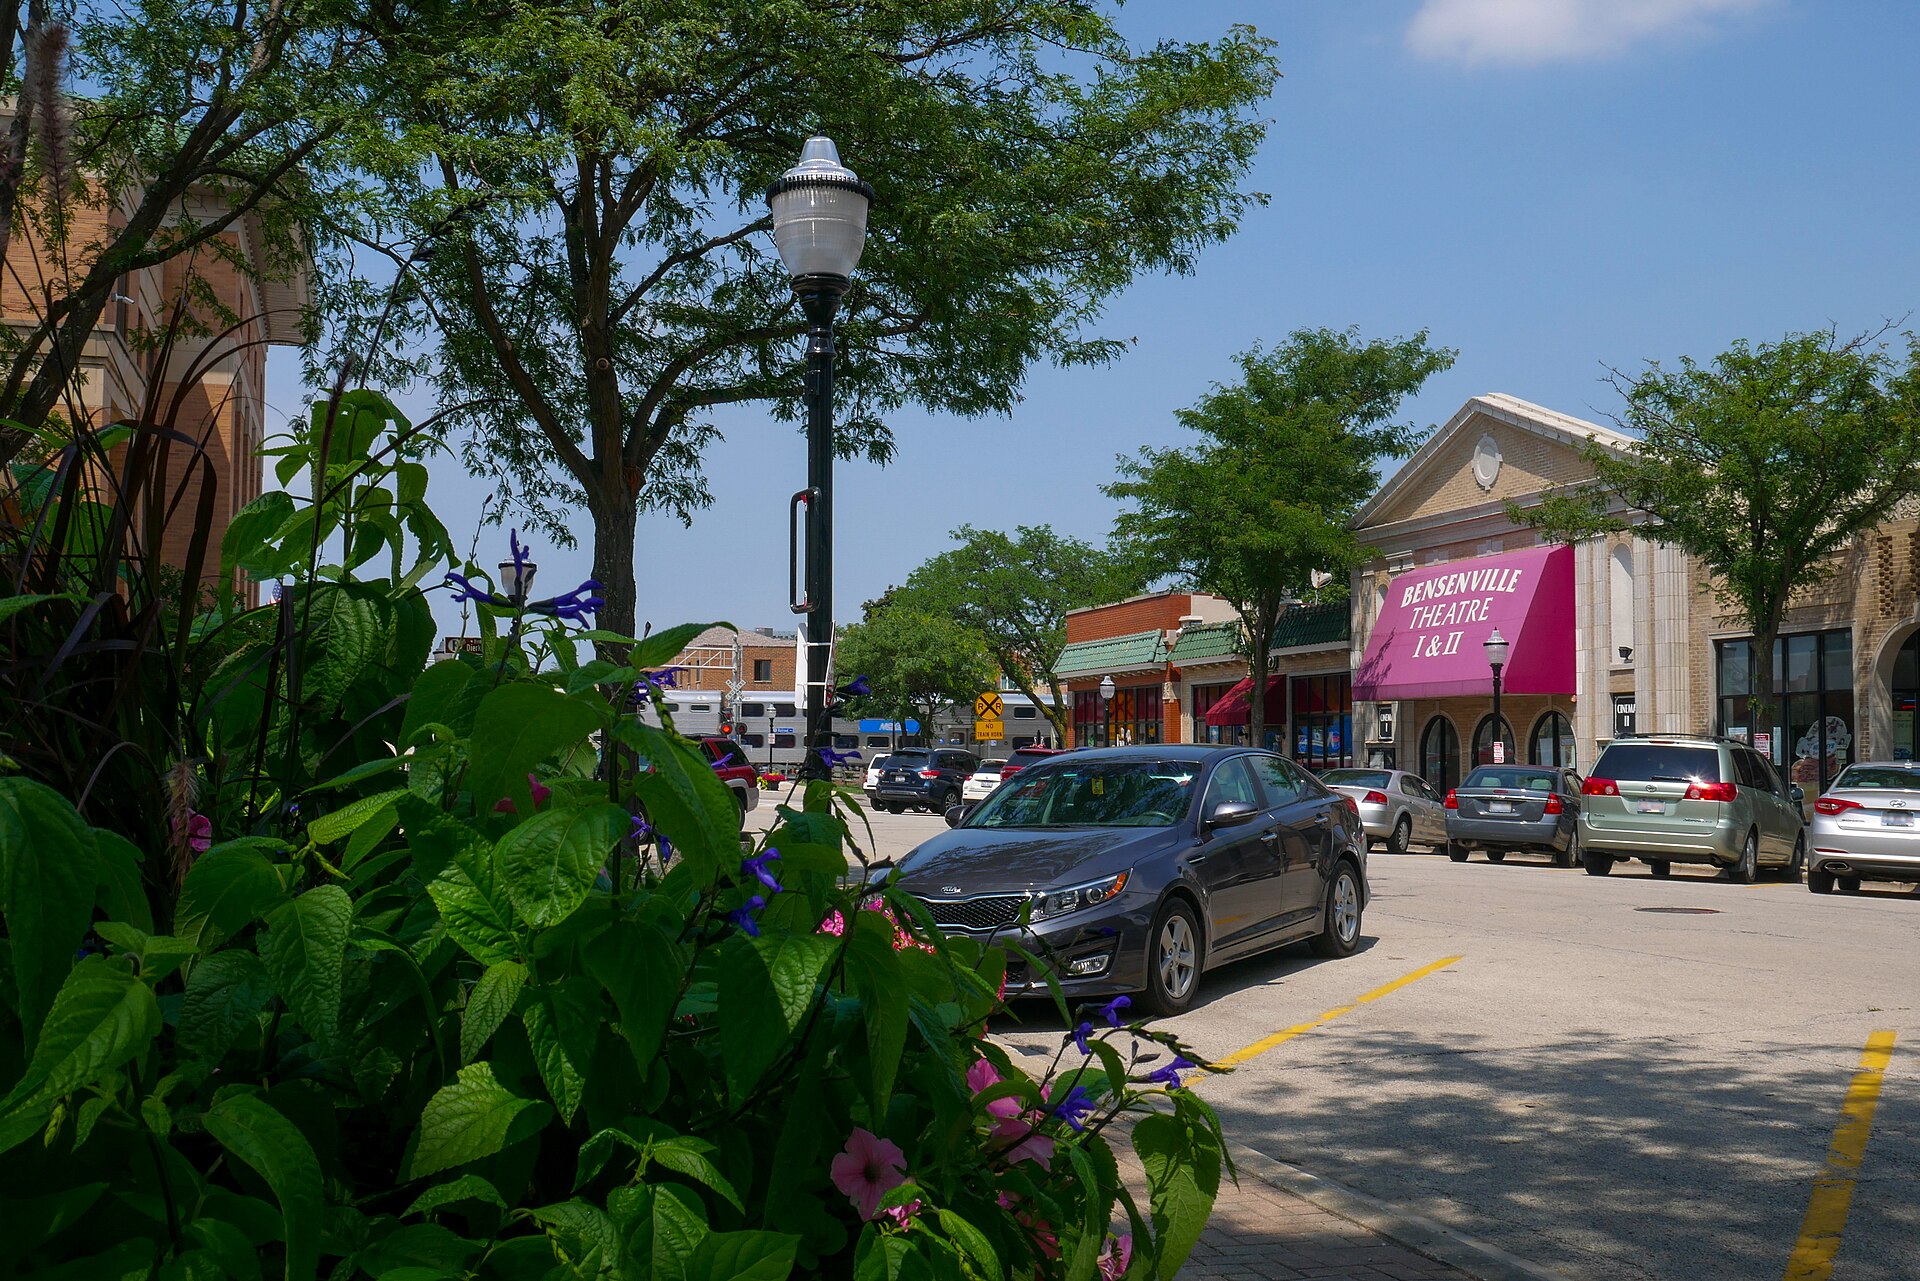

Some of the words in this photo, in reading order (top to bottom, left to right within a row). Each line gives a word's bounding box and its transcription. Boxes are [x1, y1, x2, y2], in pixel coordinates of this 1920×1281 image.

[1400, 568, 1522, 608] BENSENVILLE
[1409, 597, 1493, 629] THEATRE
[1412, 635, 1426, 658] I
[1425, 635, 1442, 657] &
[1442, 631, 1464, 655] II
[977, 702, 984, 710] R
[995, 702, 1002, 710] R
